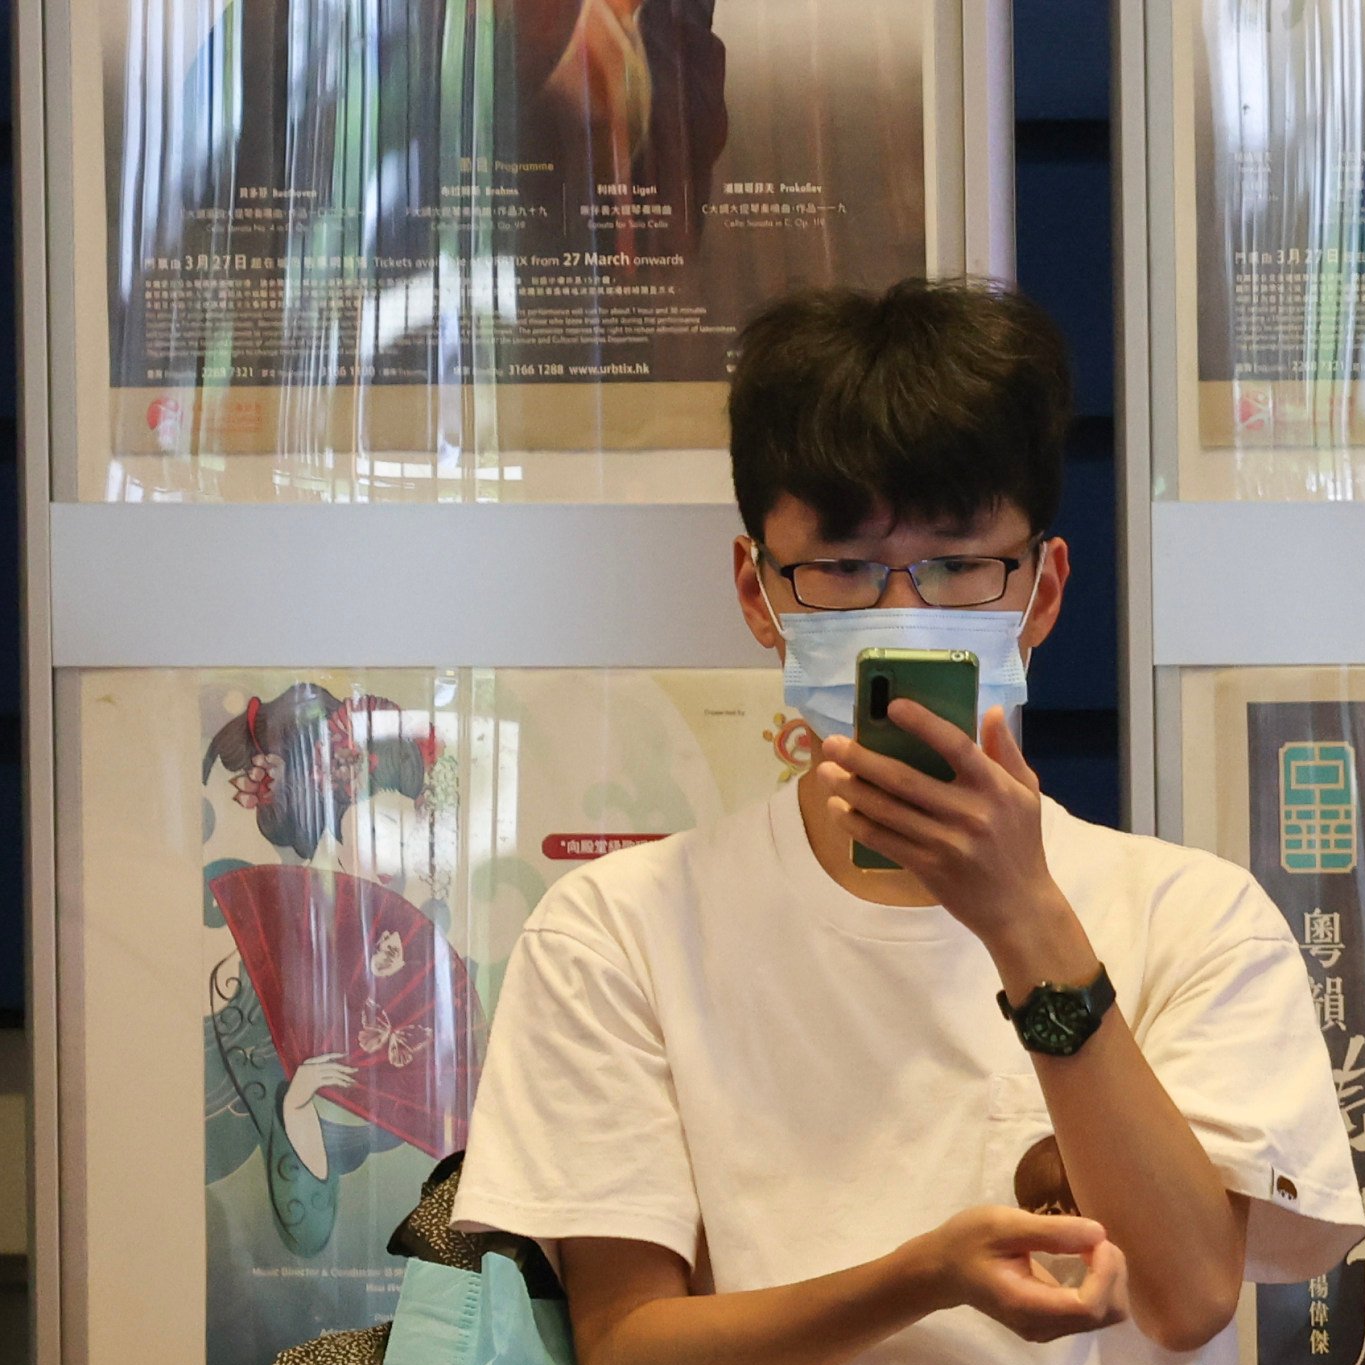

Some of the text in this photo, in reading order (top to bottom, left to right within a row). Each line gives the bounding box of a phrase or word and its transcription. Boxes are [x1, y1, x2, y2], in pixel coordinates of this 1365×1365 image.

[509, 362, 650, 376] 3166 1288 www.urbtix.hk
